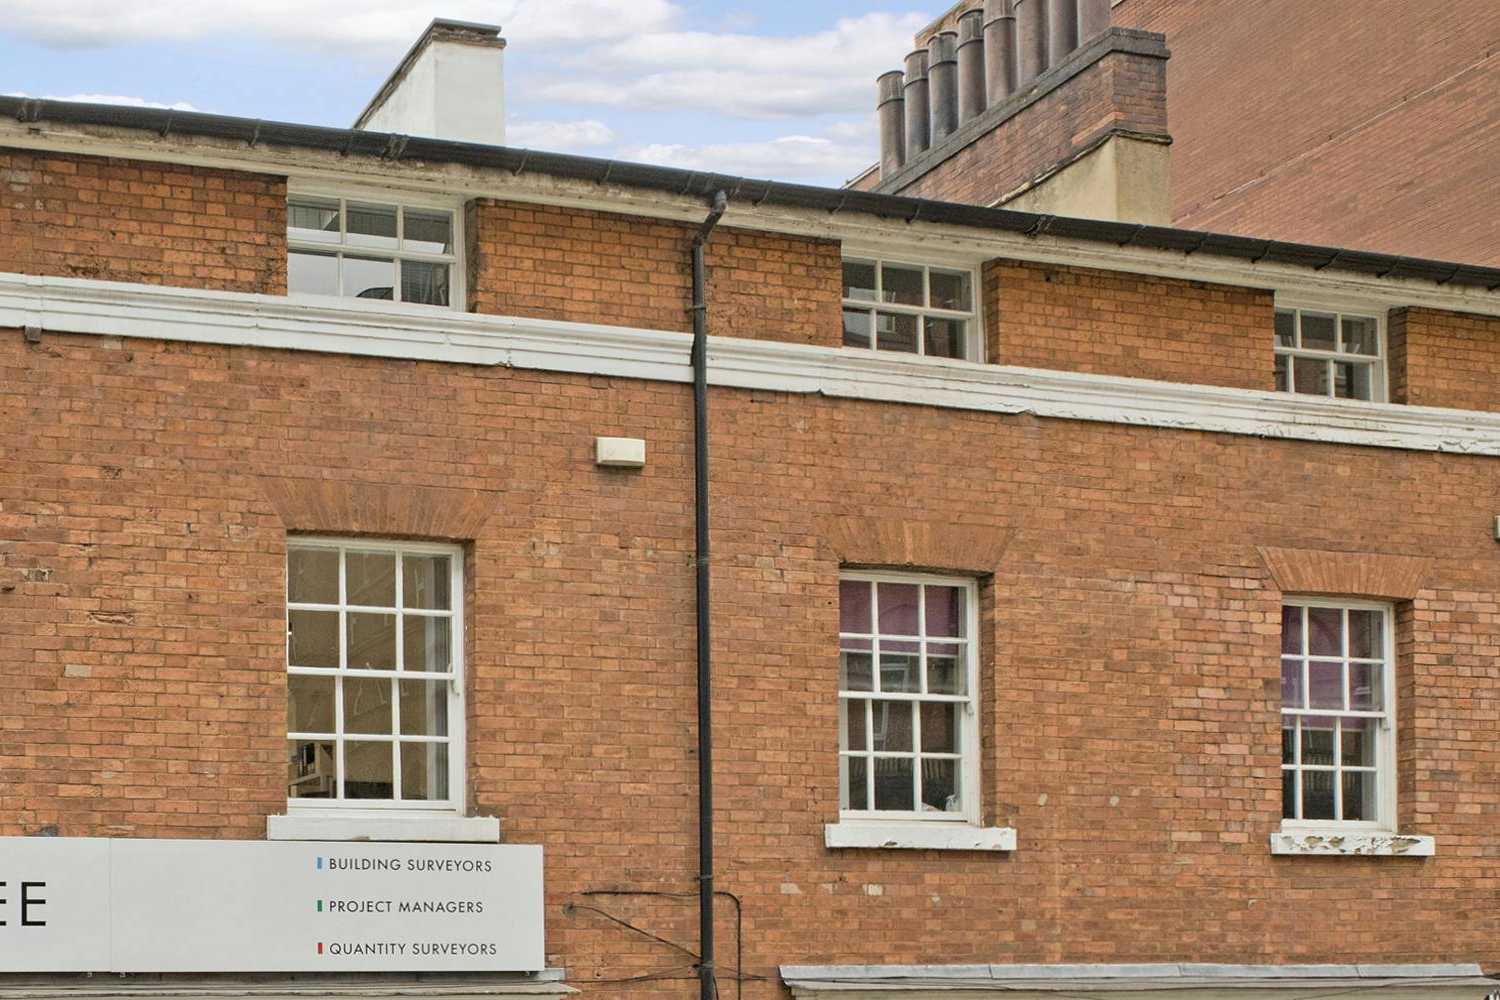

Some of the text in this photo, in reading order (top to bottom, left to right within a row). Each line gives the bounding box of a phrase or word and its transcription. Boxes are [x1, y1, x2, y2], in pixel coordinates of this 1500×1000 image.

[329, 858, 492, 872] BUILDING SURVEYORS
[329, 900, 484, 913] PROJECT MANAGERS
[329, 943, 498, 956] QUANTITY SURVEYORS
